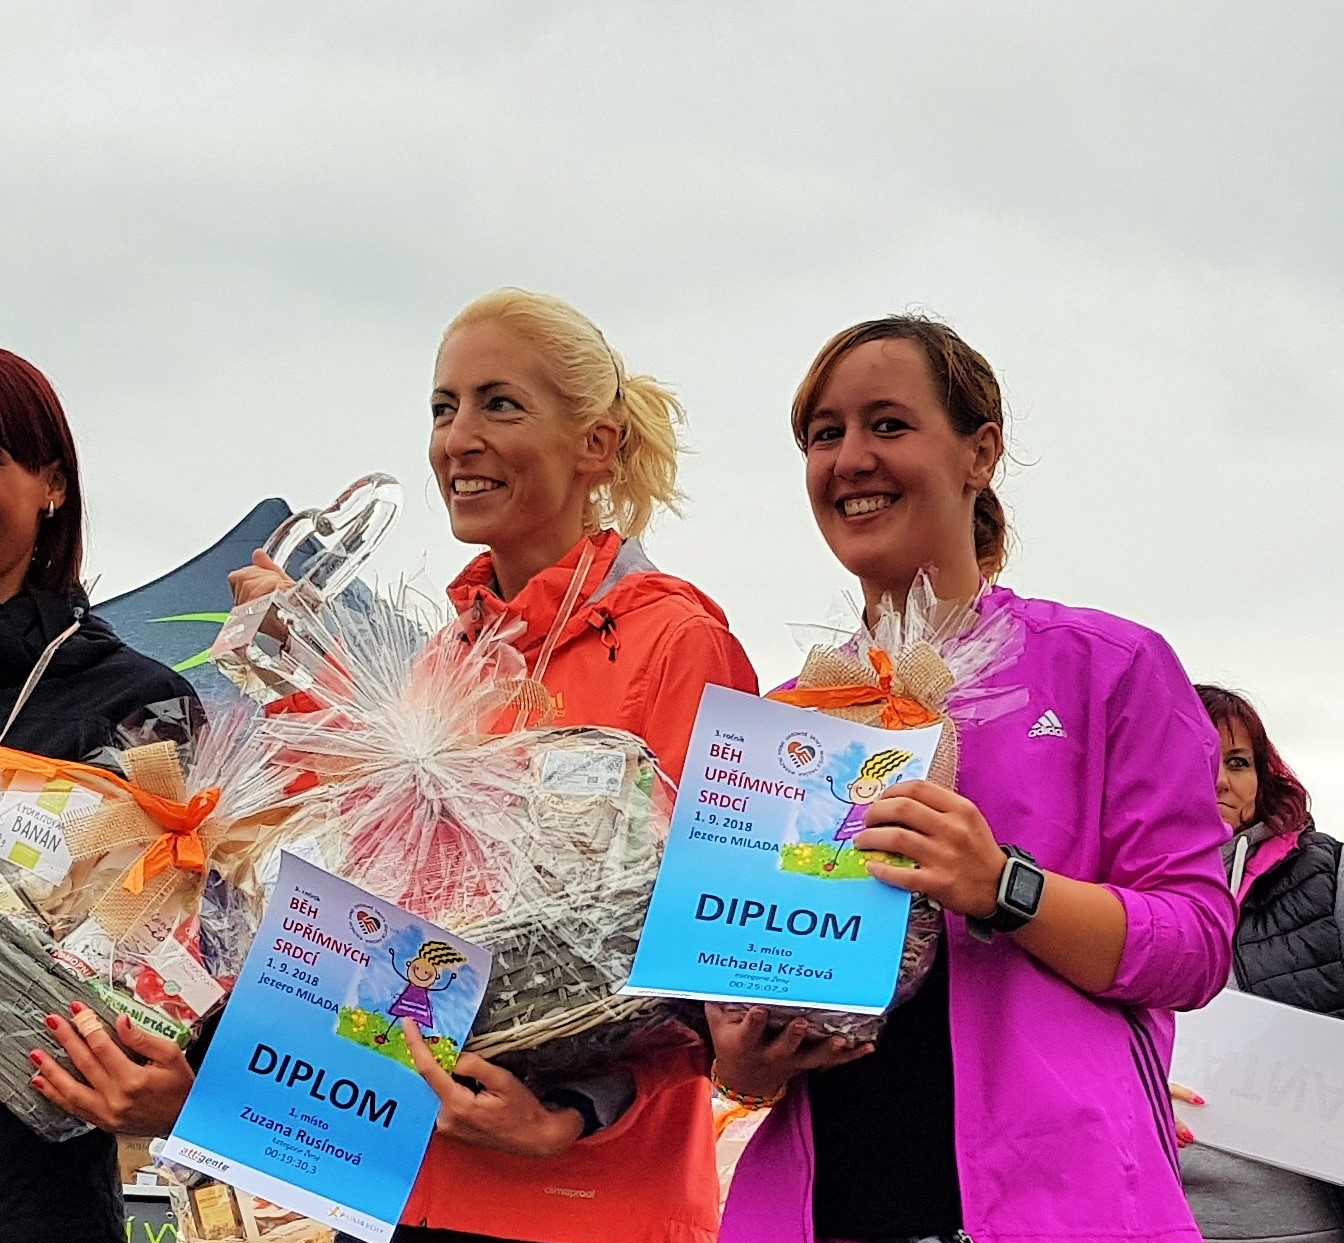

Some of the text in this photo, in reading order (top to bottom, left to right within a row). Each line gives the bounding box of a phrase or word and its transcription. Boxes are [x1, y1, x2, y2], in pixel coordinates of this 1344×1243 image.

[709, 742, 743, 764] BĚH
[704, 766, 806, 802] UPŘÍMNÝCH
[698, 789, 749, 812] SRDCÍ
[11, 815, 62, 853] BANÁN
[722, 817, 753, 832] 2018
[689, 827, 779, 853] jezero MILADA
[289, 896, 319, 920] BĚH
[694, 893, 862, 942] DIPLOM
[273, 938, 321, 967] SRDCÍ
[282, 917, 371, 968] UPŘÍMNÝCH
[746, 943, 793, 958] 3. místo
[292, 968, 320, 987] 2018
[696, 951, 833, 981] Michaela Kršová
[257, 971, 340, 1015] jezero MILADA
[142, 1013, 179, 1040] PTÁČE
[246, 1041, 398, 1129] DIPLOM
[239, 1105, 363, 1166] Zuzana Rusínová
[300, 1113, 330, 1131] místo
